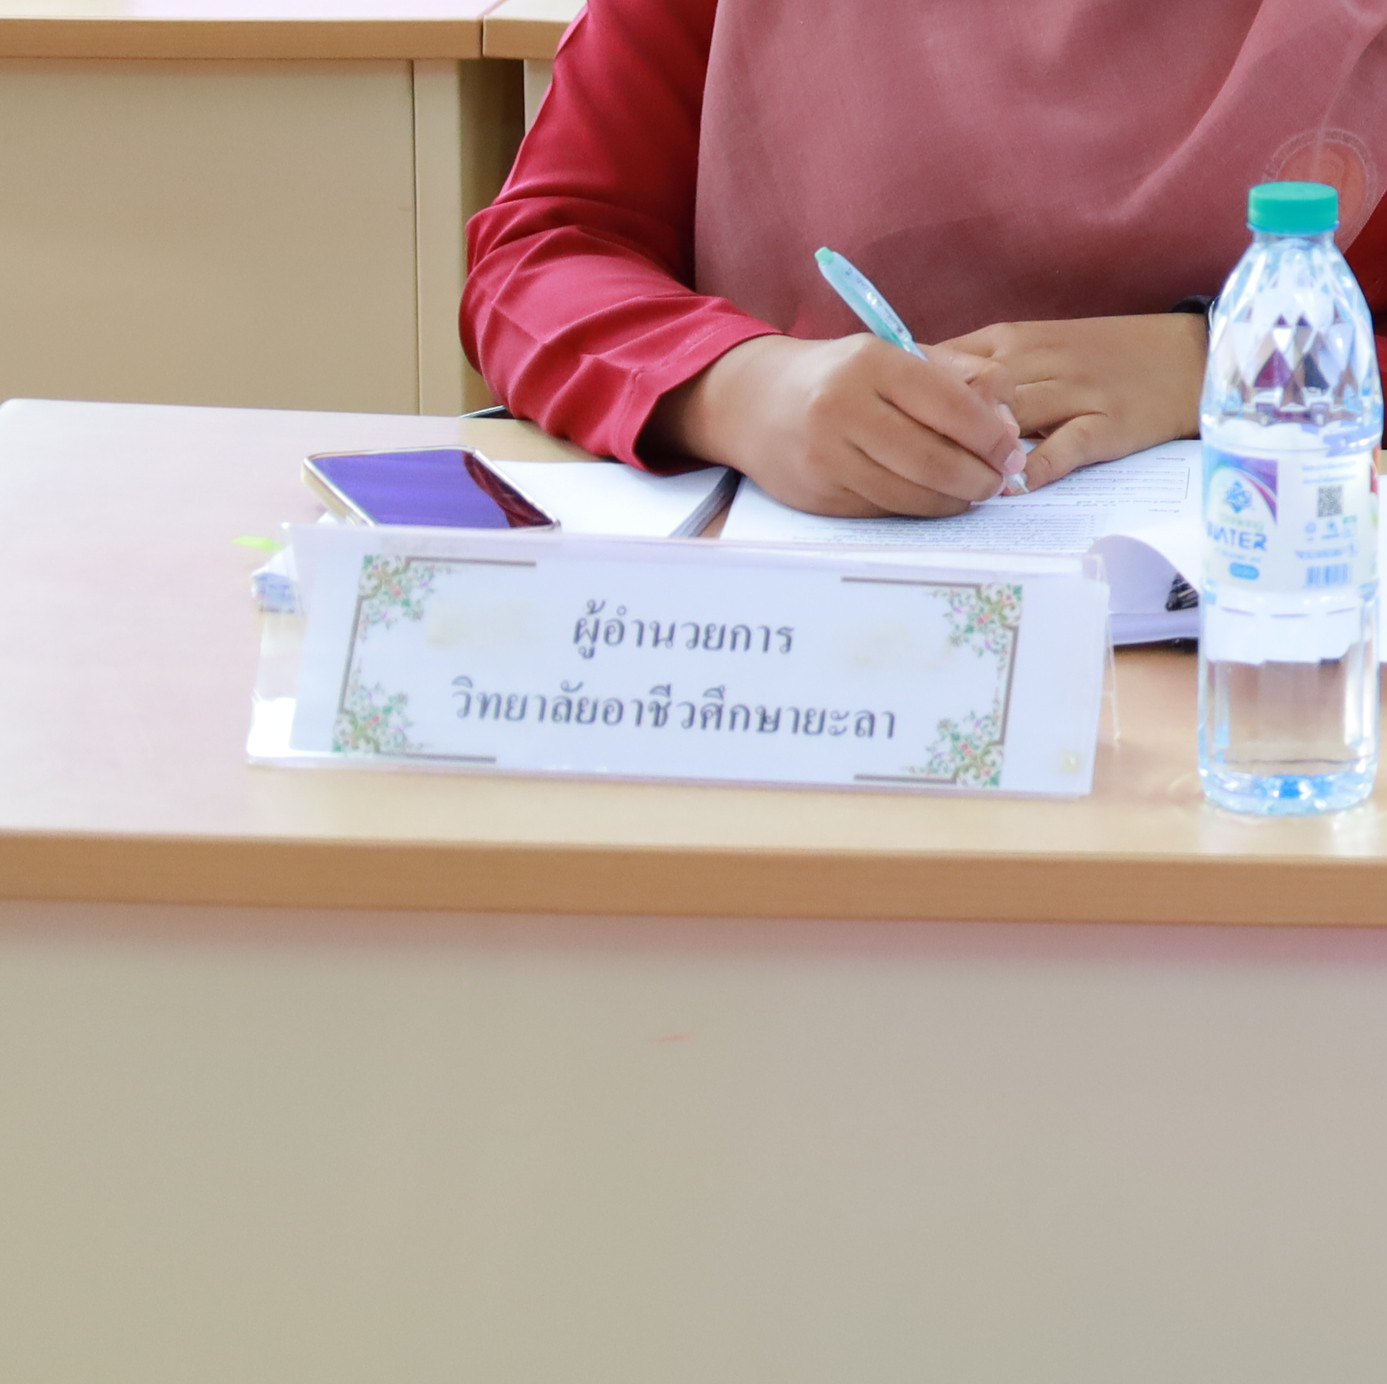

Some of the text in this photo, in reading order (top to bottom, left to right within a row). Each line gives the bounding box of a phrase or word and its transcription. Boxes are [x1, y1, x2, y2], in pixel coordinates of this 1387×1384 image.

[571, 599, 796, 658] ผู้อำนวยการ
[452, 677, 898, 740] วิทยาลัยอาชีวศึกษายะลา
